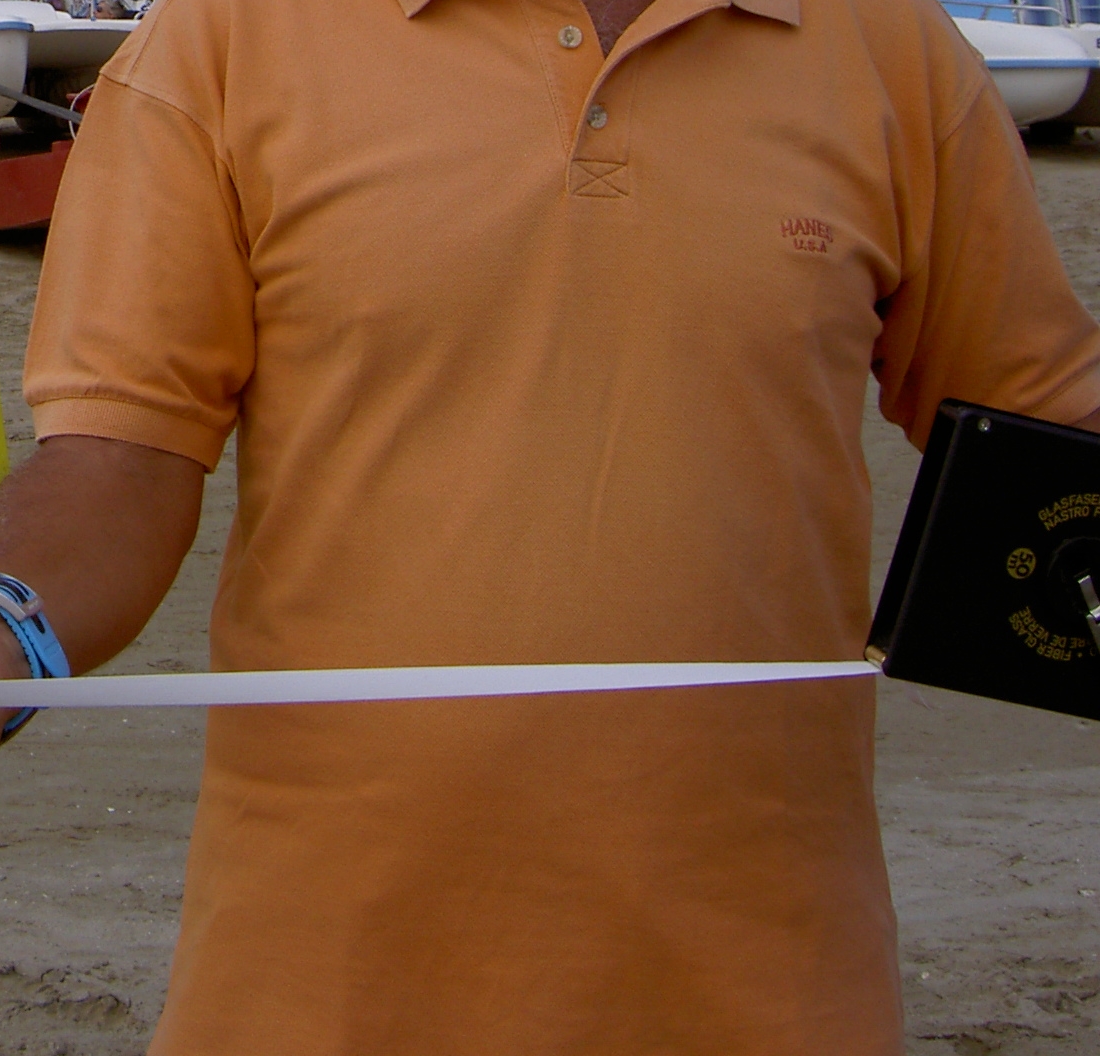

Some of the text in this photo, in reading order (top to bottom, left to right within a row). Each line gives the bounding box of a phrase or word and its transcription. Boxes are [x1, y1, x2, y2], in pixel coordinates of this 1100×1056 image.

[1038, 493, 1100, 521] GLASFASE
[1043, 506, 1090, 531] NASTRO
[1008, 554, 1018, 569] m
[1016, 551, 1033, 577] 50
[1008, 612, 1038, 648] GLASS
[1018, 605, 1049, 643] VERRE
[1036, 642, 1072, 661] FIBER
